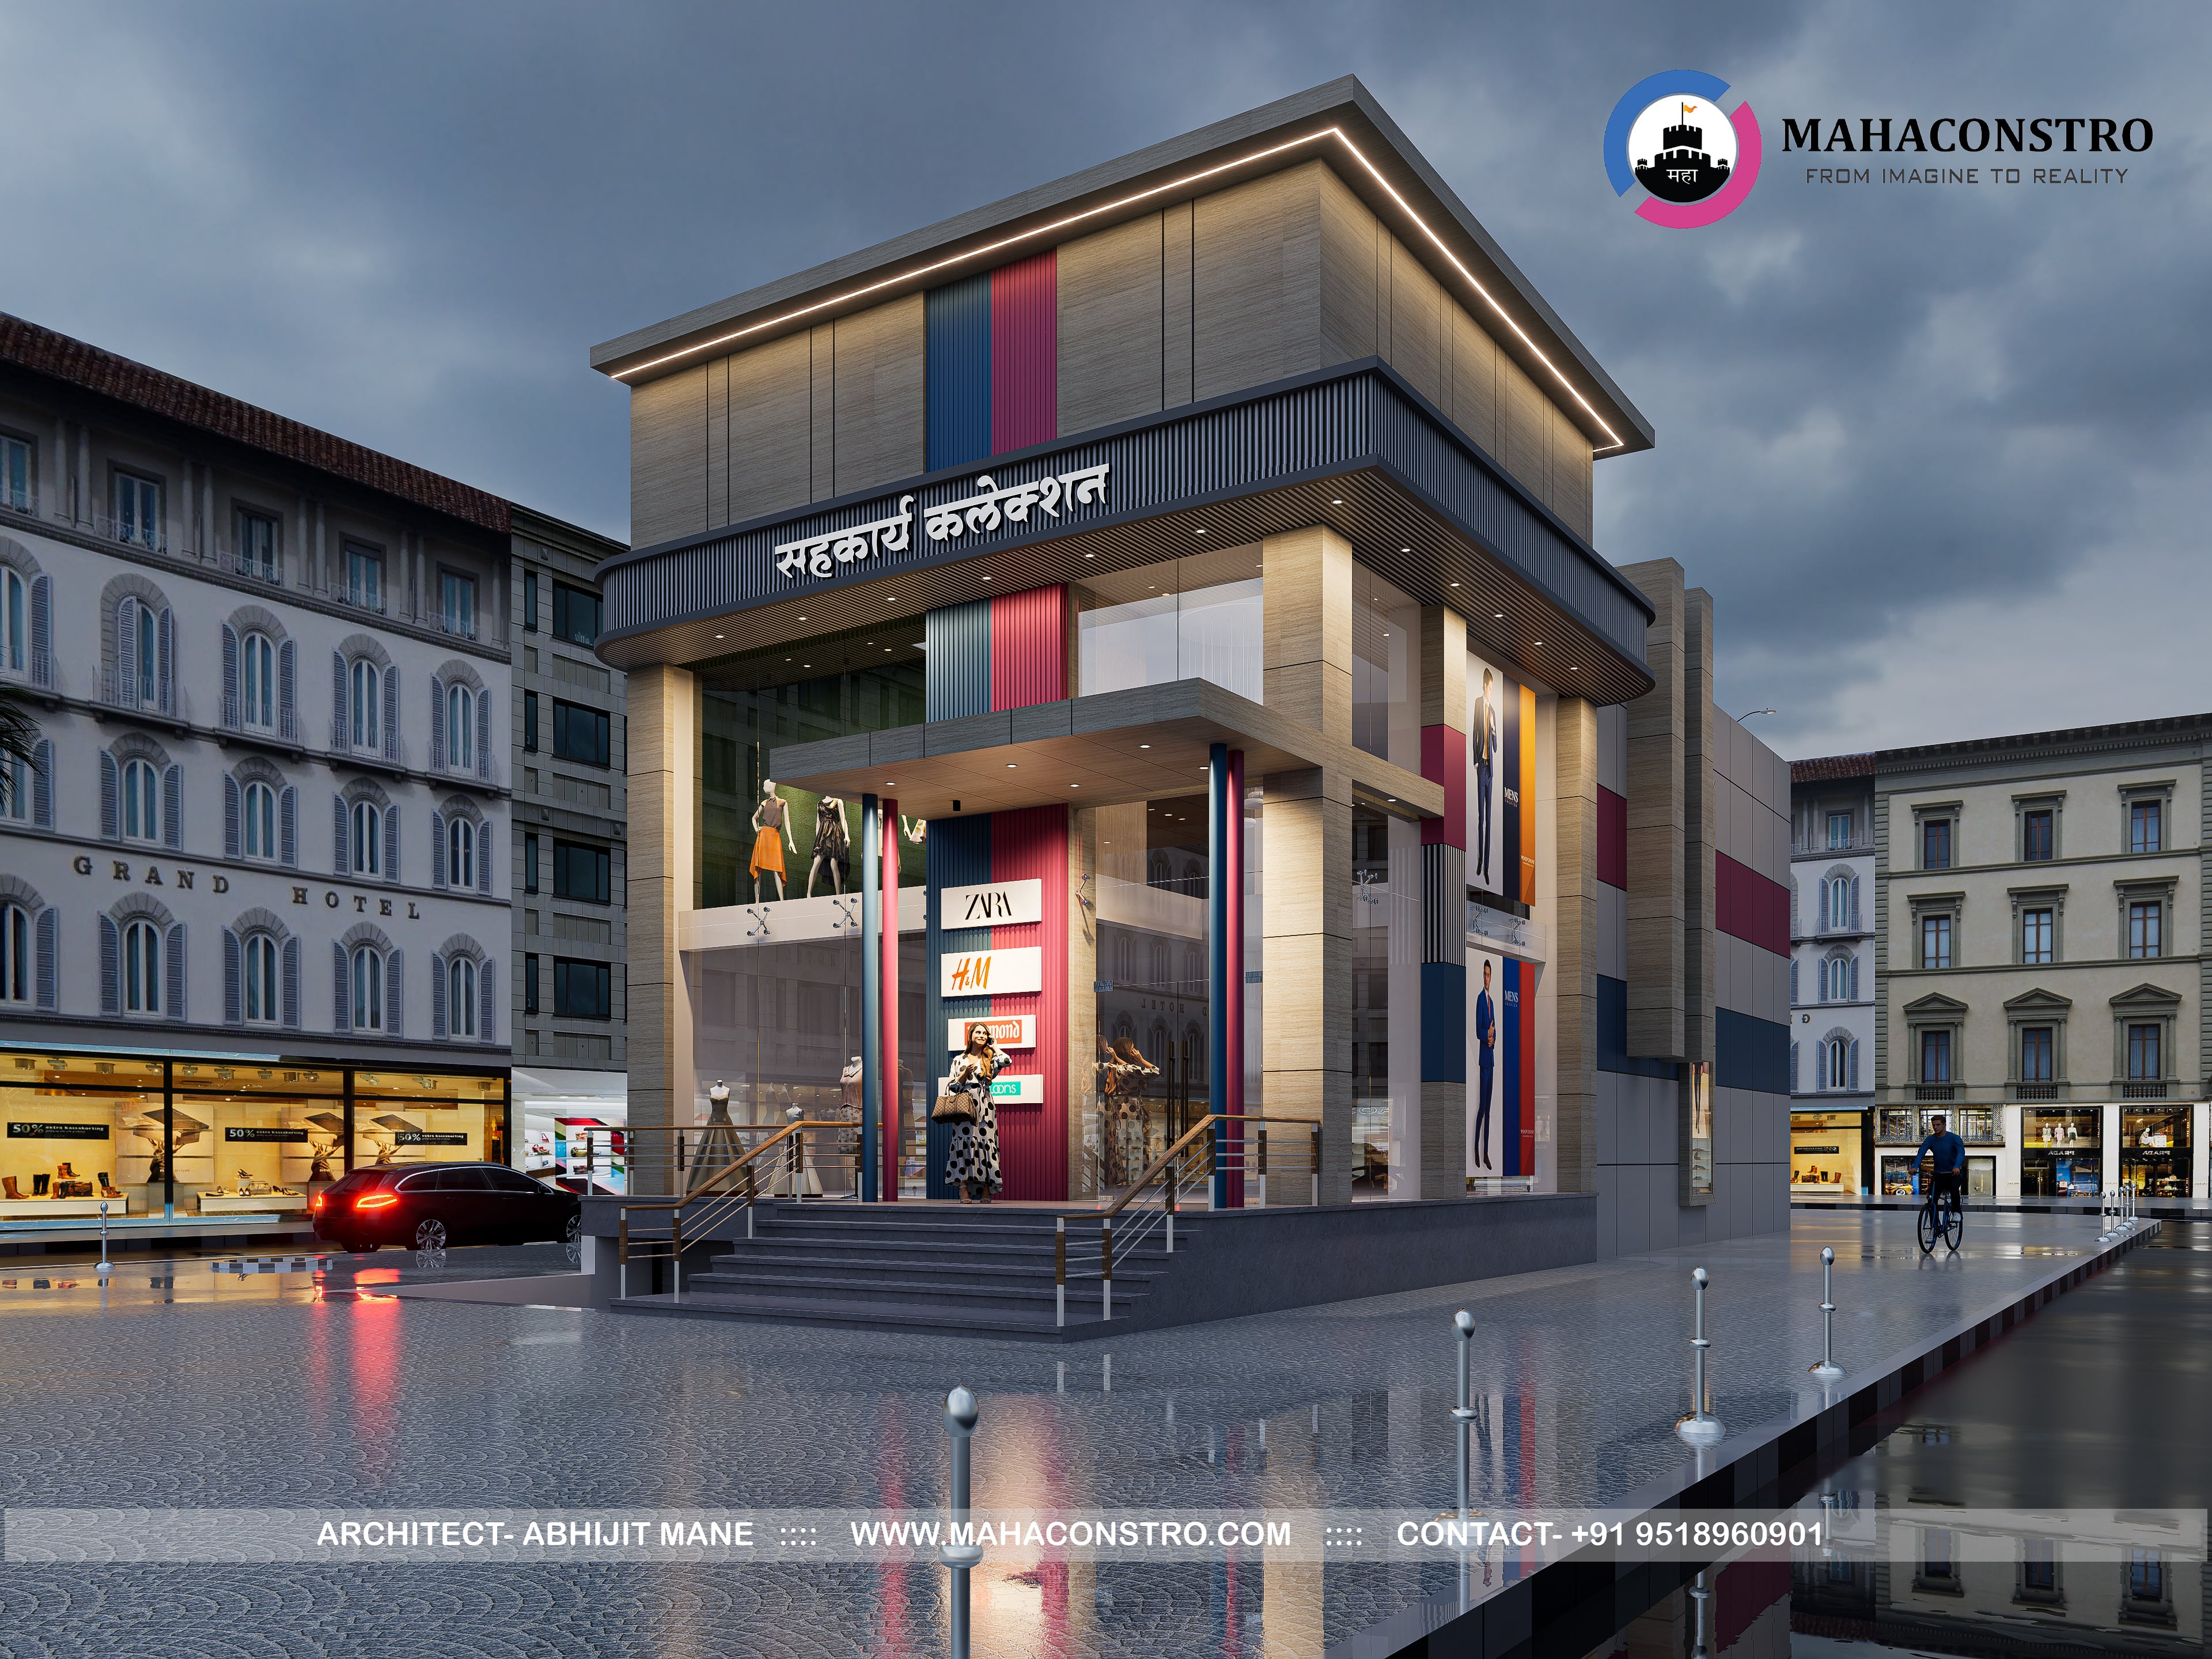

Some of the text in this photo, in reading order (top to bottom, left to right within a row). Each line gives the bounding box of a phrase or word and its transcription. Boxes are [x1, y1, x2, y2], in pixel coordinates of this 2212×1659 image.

[775, 463, 1110, 578] सहकार्य कलेक्शन
[73, 855, 421, 920] GRAND HOTEL
[965, 891, 1012, 920] ZARA
[952, 956, 991, 991] H&M
[13, 1124, 44, 1133] 50%
[229, 1128, 255, 1138] 50%
[398, 1133, 421, 1141] 50%
